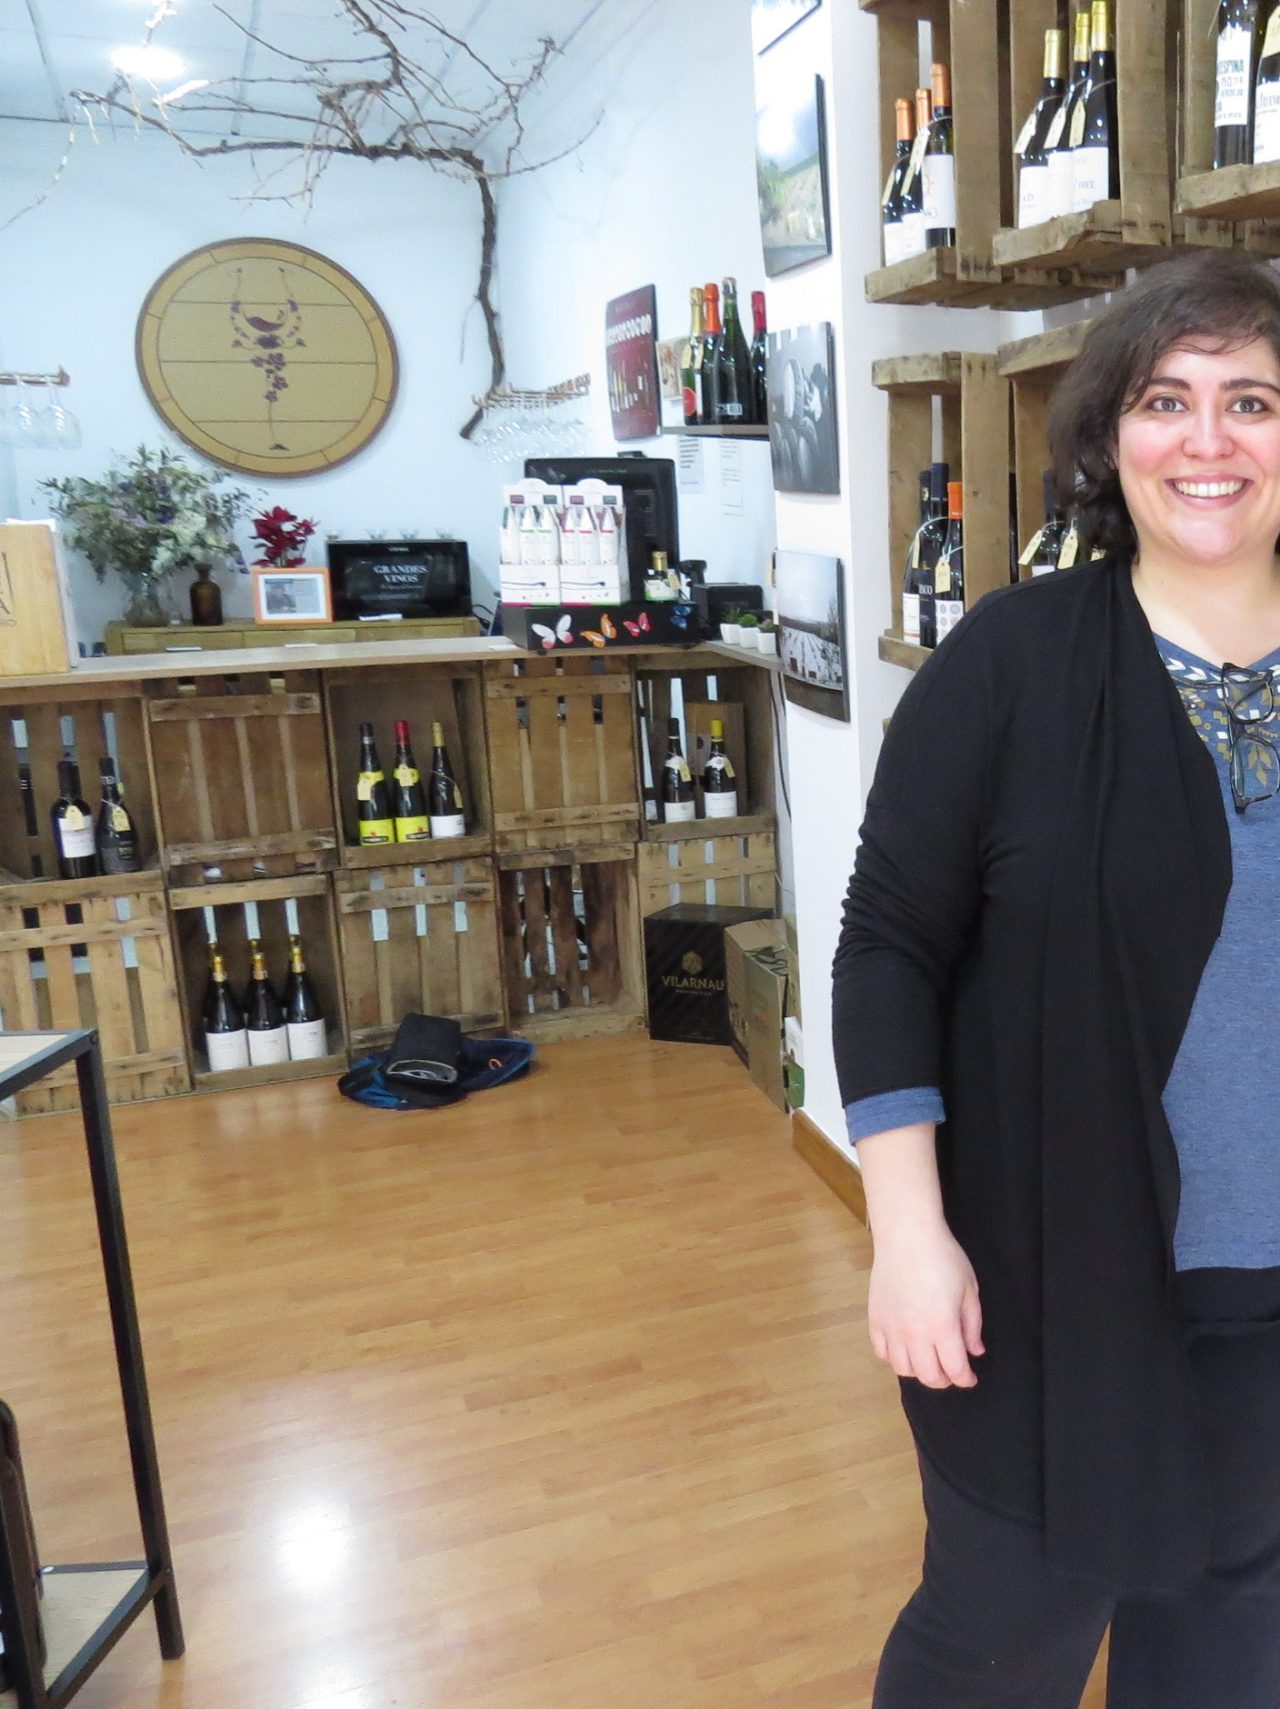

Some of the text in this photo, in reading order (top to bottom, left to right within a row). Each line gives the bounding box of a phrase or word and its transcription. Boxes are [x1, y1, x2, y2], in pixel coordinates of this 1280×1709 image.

[372, 564, 429, 575] GRANDES
[383, 574, 419, 583] VINOS
[661, 975, 725, 991] VILARNAU
